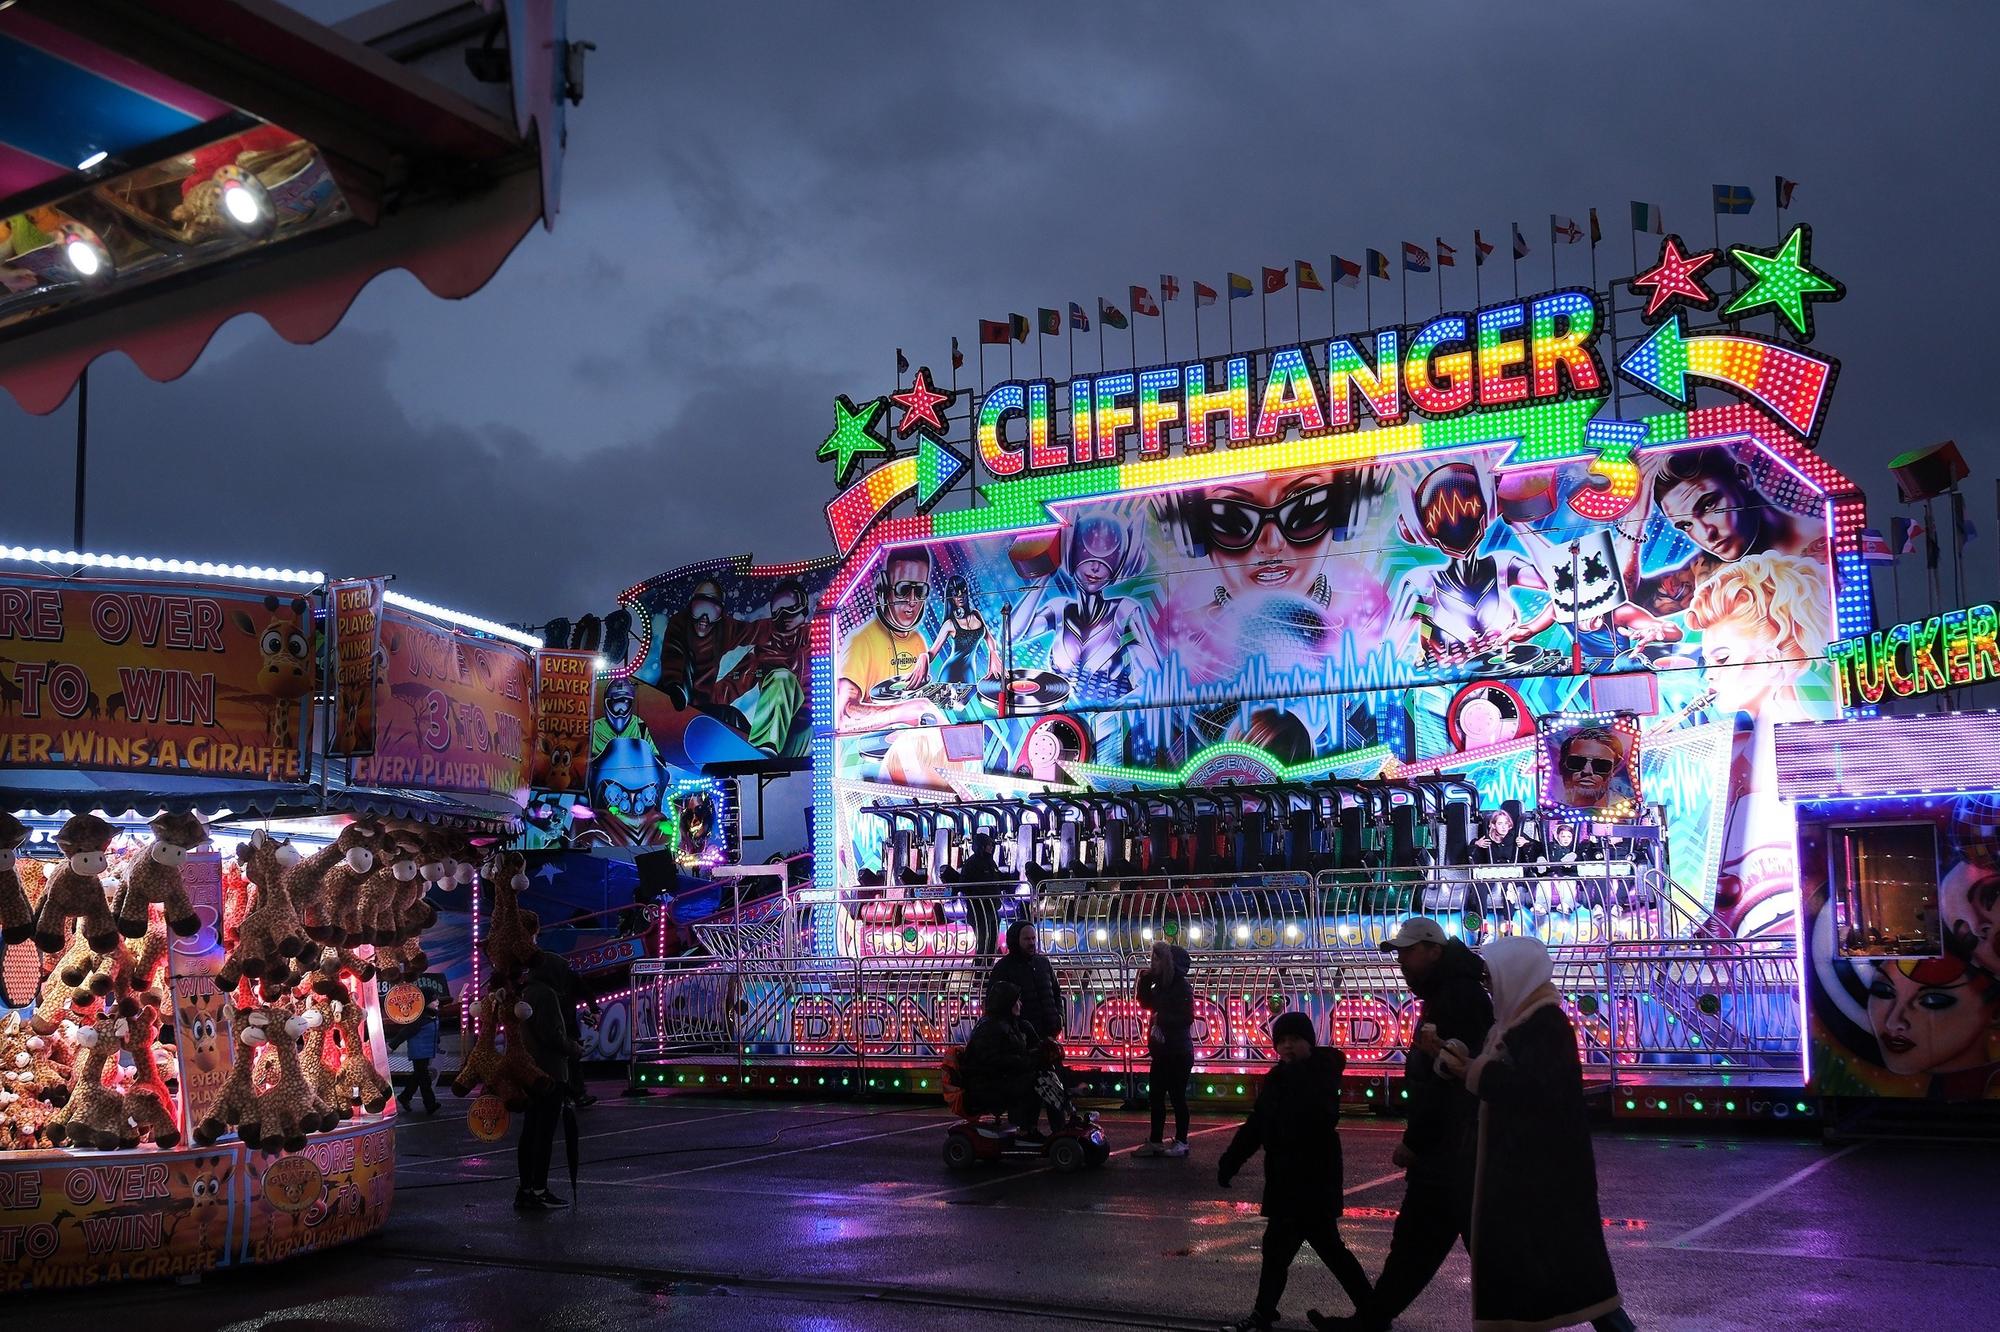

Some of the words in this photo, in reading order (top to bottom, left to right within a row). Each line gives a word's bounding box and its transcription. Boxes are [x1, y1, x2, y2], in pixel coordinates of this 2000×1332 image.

[974, 288, 1603, 478] CLIFFHANGER
[1567, 418, 1649, 520] 3
[341, 589, 374, 611] EVERY
[91, 594, 223, 650] OVER
[340, 613, 376, 635] PLAYER
[545, 658, 588, 676] EVERY
[1828, 604, 2000, 707] TUCKER
[14, 662, 89, 717] TO
[119, 667, 215, 725] WIN
[541, 677, 590, 696] PLAYER
[424, 689, 450, 749] 3
[460, 703, 489, 751] TO
[540, 699, 574, 715] WINS
[577, 699, 588, 715] A
[537, 717, 590, 735] GIRAFFE
[62, 730, 150, 767] WINS
[158, 738, 178, 768] A
[187, 737, 300, 776] GIRAFFE
[356, 756, 417, 786] EVERY
[421, 754, 480, 788] PLAYER
[185, 960, 210, 974] TO
[177, 977, 223, 998] WIN
[191, 1070, 229, 1087] EVERY
[270, 1171, 319, 1185] GIRAFFE
[278, 1159, 305, 1169] FREE
[64, 1163, 171, 1205] OVER
[338, 1183, 361, 1216] TO
[0, 1222, 59, 1262] TO
[83, 1212, 163, 1255] WIN
[33, 1262, 100, 1288] WINS
[107, 1262, 122, 1282] A
[128, 1251, 217, 1280] GIRAFFE
